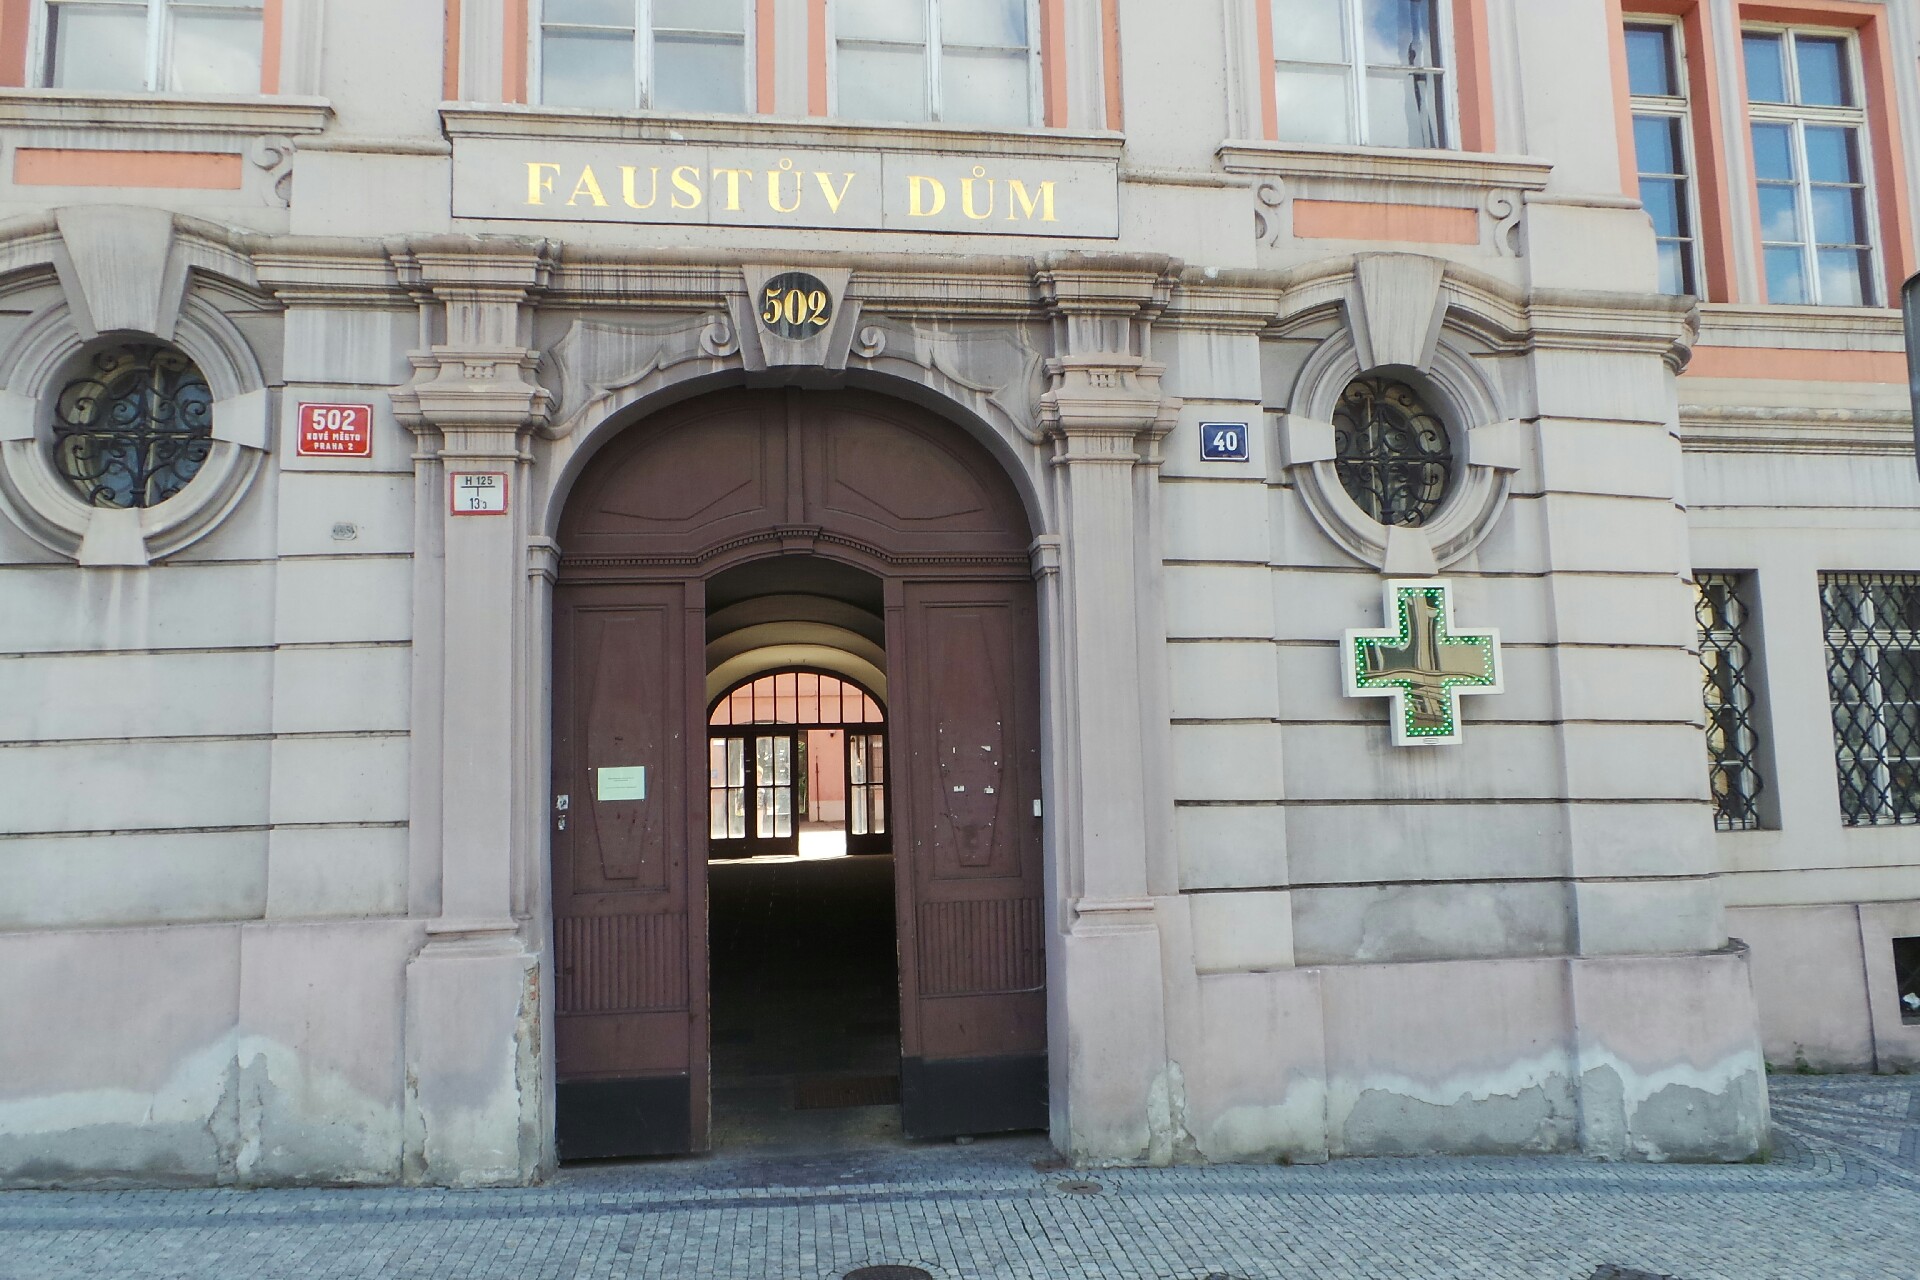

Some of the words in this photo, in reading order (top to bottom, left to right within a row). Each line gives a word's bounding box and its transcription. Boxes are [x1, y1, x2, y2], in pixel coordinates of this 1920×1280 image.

[523, 158, 856, 215] FAUSTŮV
[907, 165, 1060, 222] DŮM
[763, 287, 830, 326] 502
[312, 409, 356, 431] 502
[306, 431, 329, 441] NOVÉ
[332, 431, 361, 441] MĚSTO
[313, 442, 344, 450] PRAHA
[1213, 431, 1238, 451] 40
[465, 476, 472, 485] H
[476, 476, 493, 485] 125
